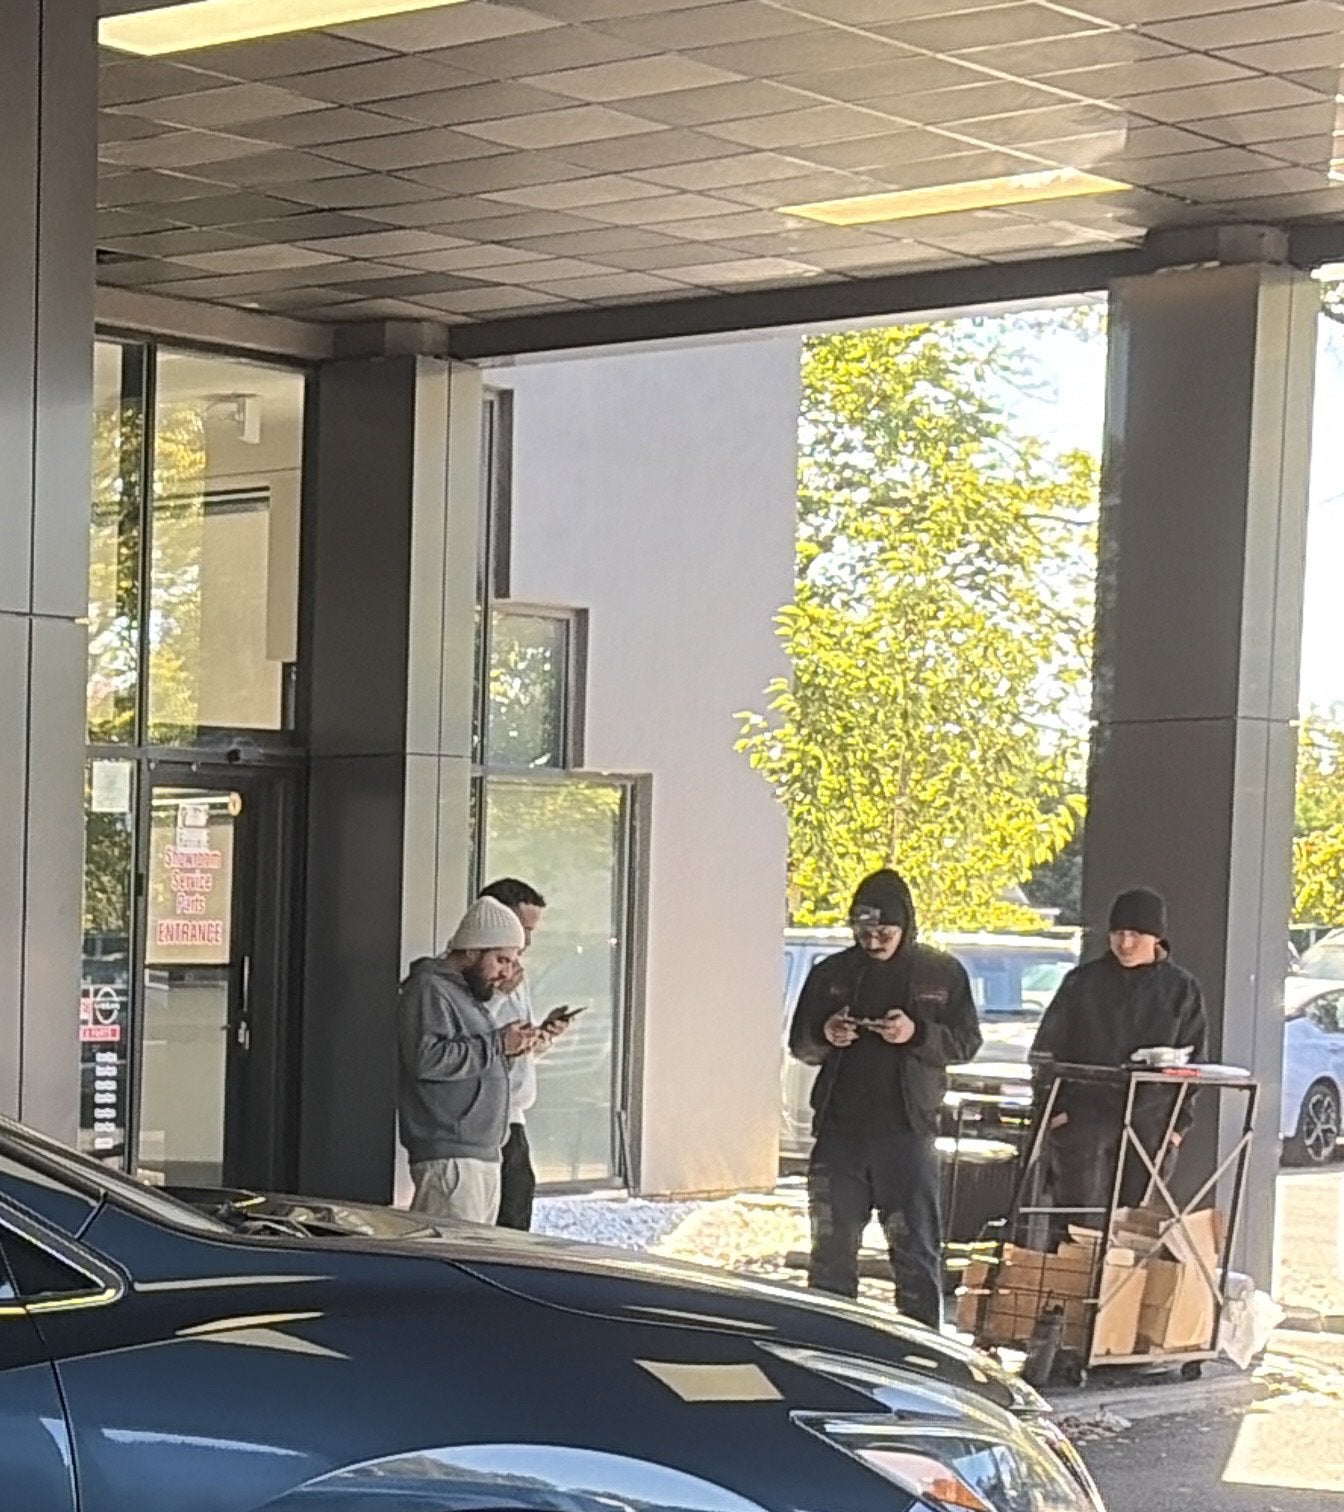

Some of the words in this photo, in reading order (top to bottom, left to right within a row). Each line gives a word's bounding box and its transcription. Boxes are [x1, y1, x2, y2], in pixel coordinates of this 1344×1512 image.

[170, 870, 213, 892] Service
[175, 893, 206, 914] Parts
[157, 921, 224, 944] ENTRANCE
